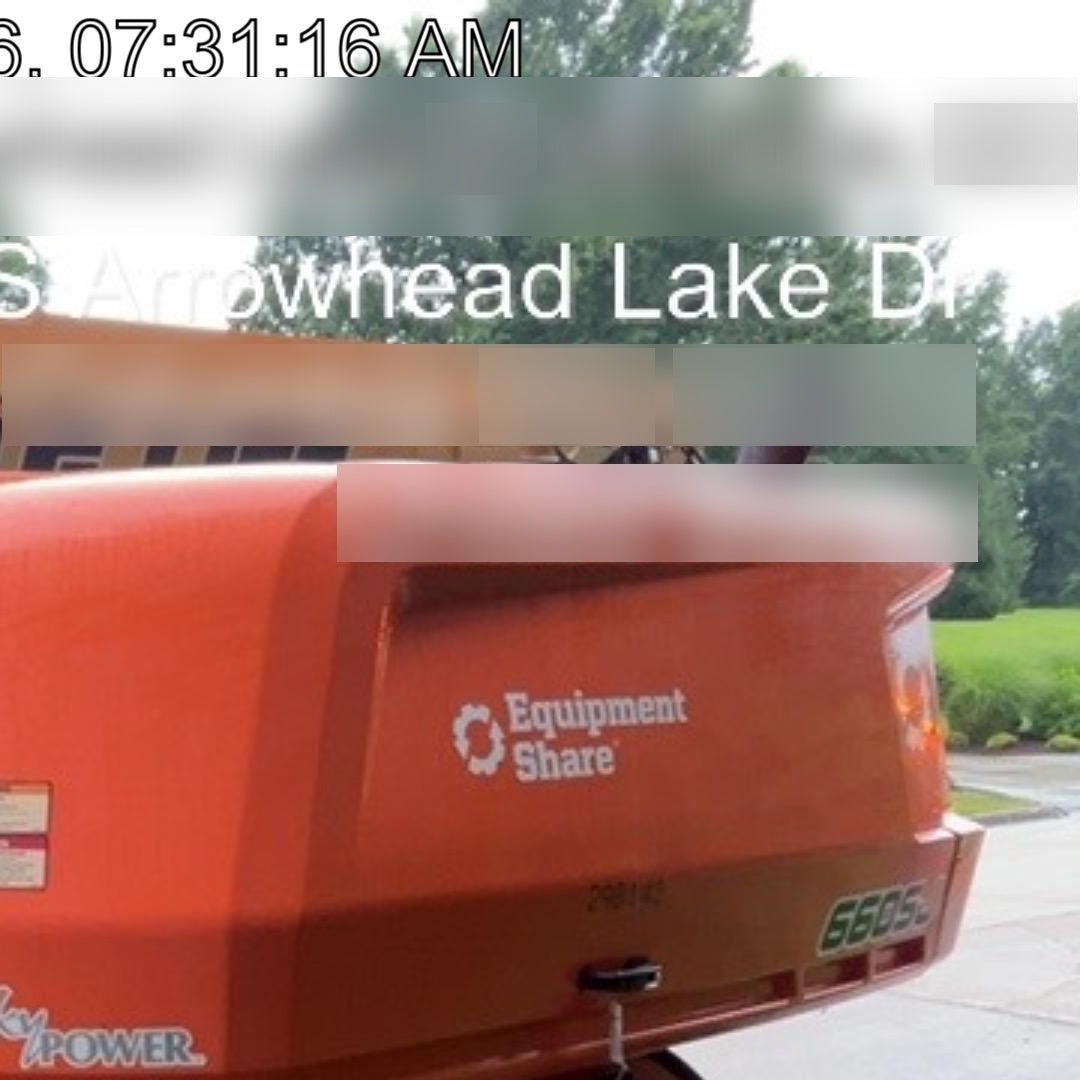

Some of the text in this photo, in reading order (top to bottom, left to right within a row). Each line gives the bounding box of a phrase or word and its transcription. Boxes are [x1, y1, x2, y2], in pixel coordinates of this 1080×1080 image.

[504, 687, 688, 740] Equipment
[513, 740, 617, 782] Share
[35, 1028, 208, 1068] POWER
